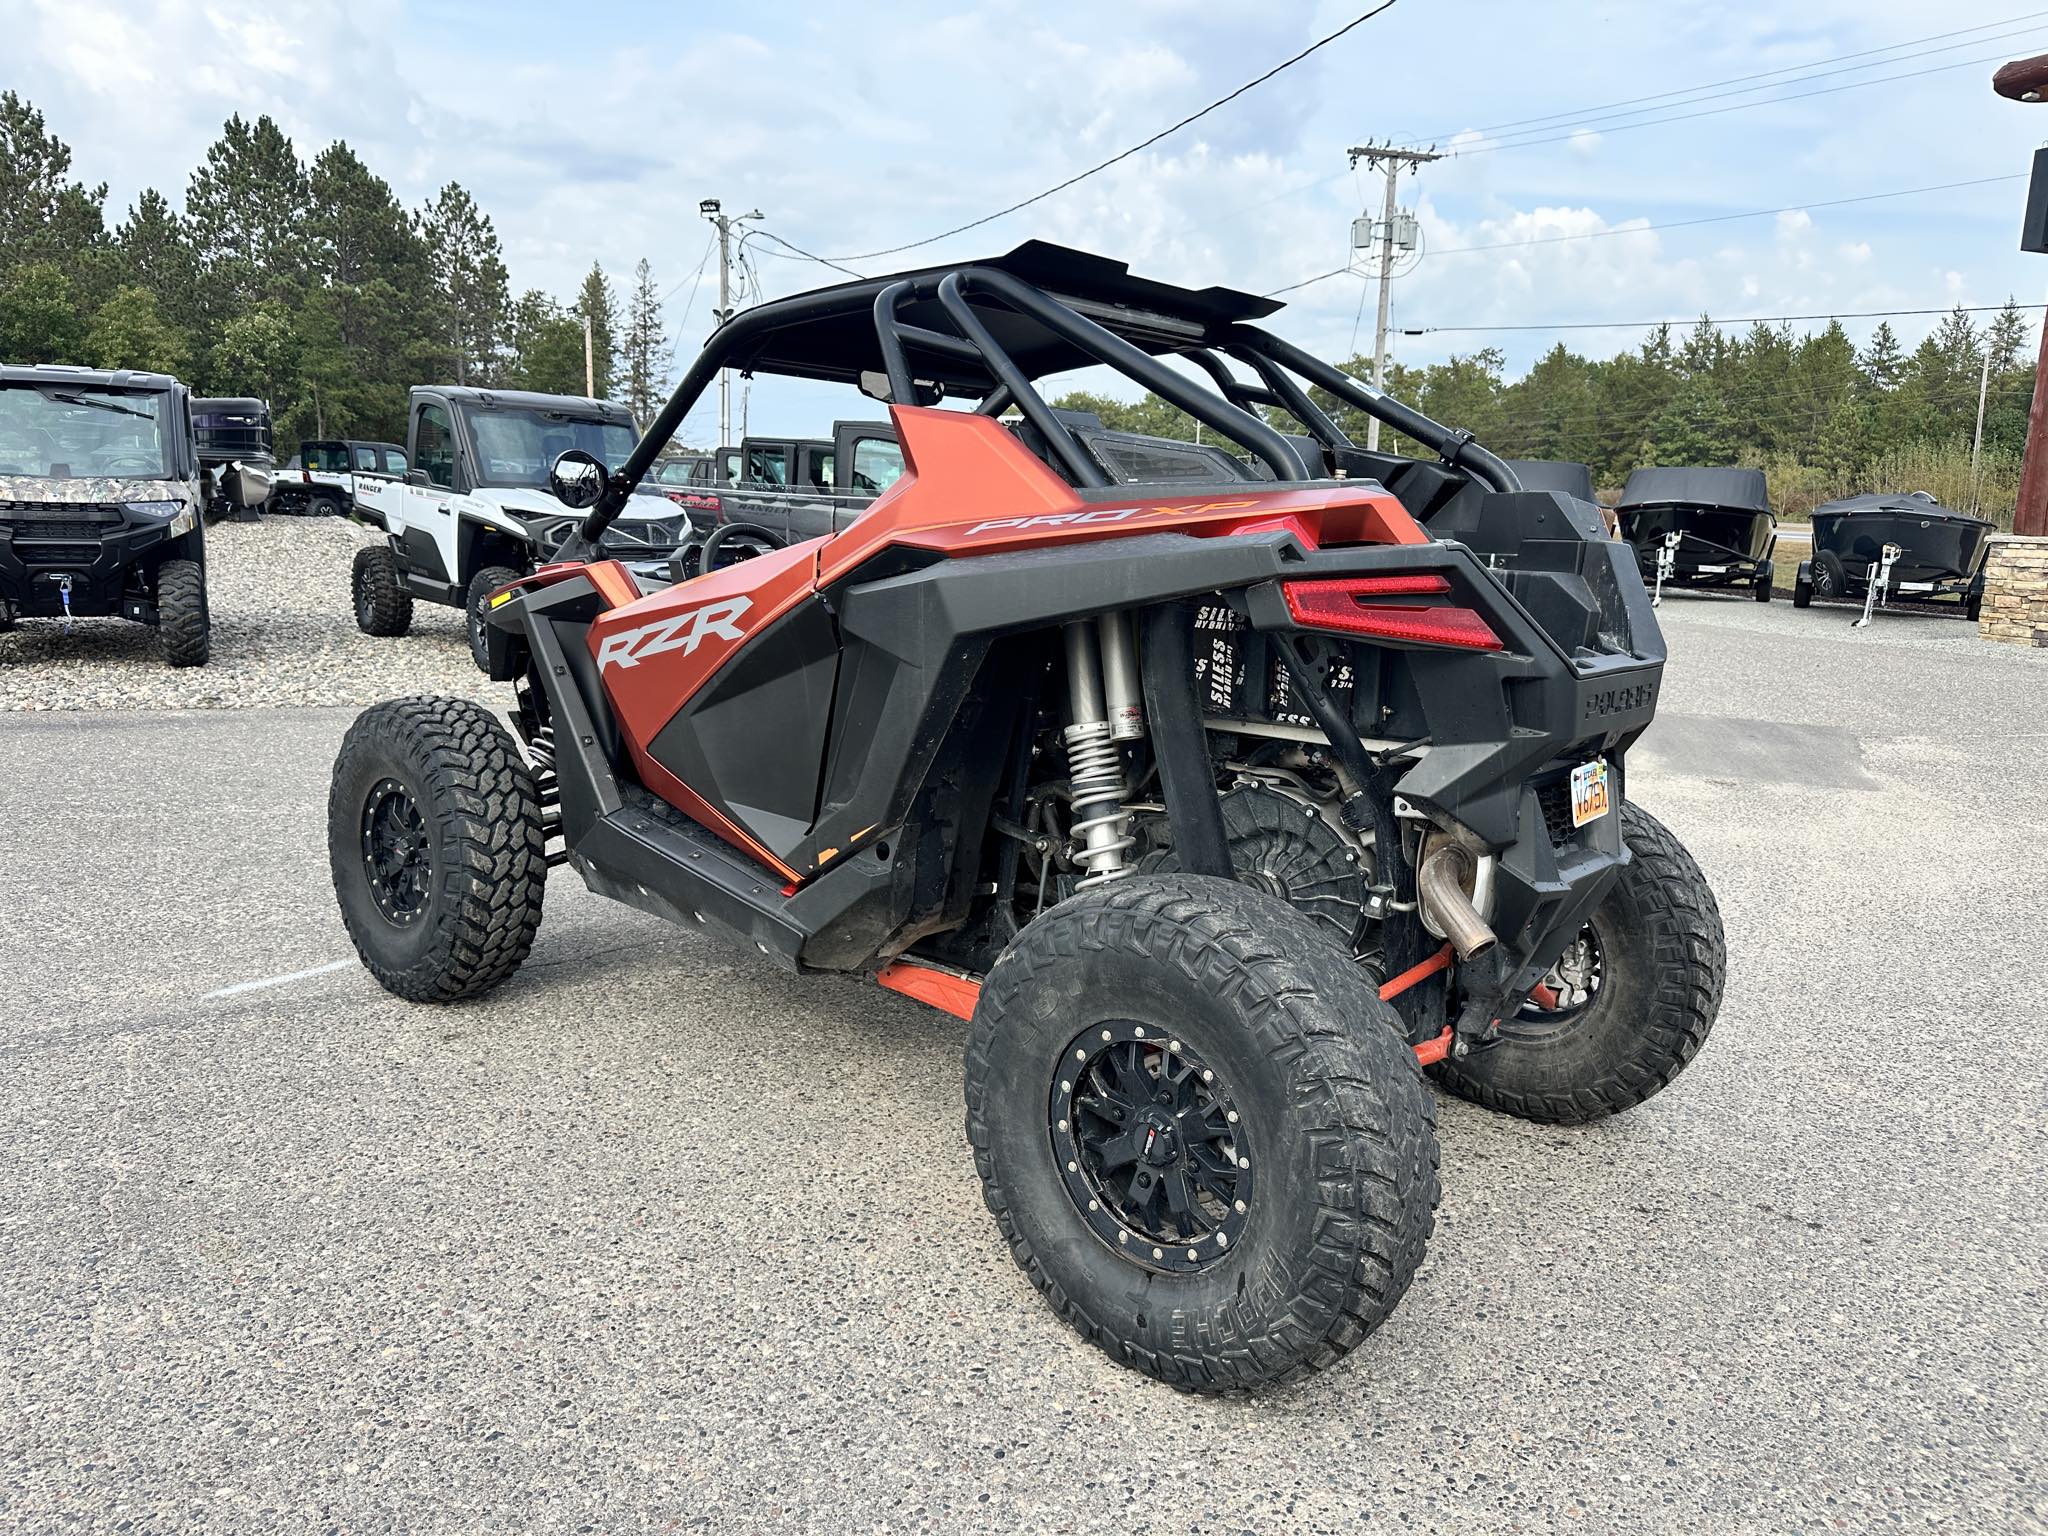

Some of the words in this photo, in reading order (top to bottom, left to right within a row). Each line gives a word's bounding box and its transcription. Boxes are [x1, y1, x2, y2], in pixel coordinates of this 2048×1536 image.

[358, 482, 382, 494] RANGER
[963, 508, 1143, 536] PRO
[1131, 500, 1262, 520] XP
[596, 595, 755, 675] RZR
[1210, 638, 1226, 704] SILESS
[1583, 682, 1654, 721] POLARIS
